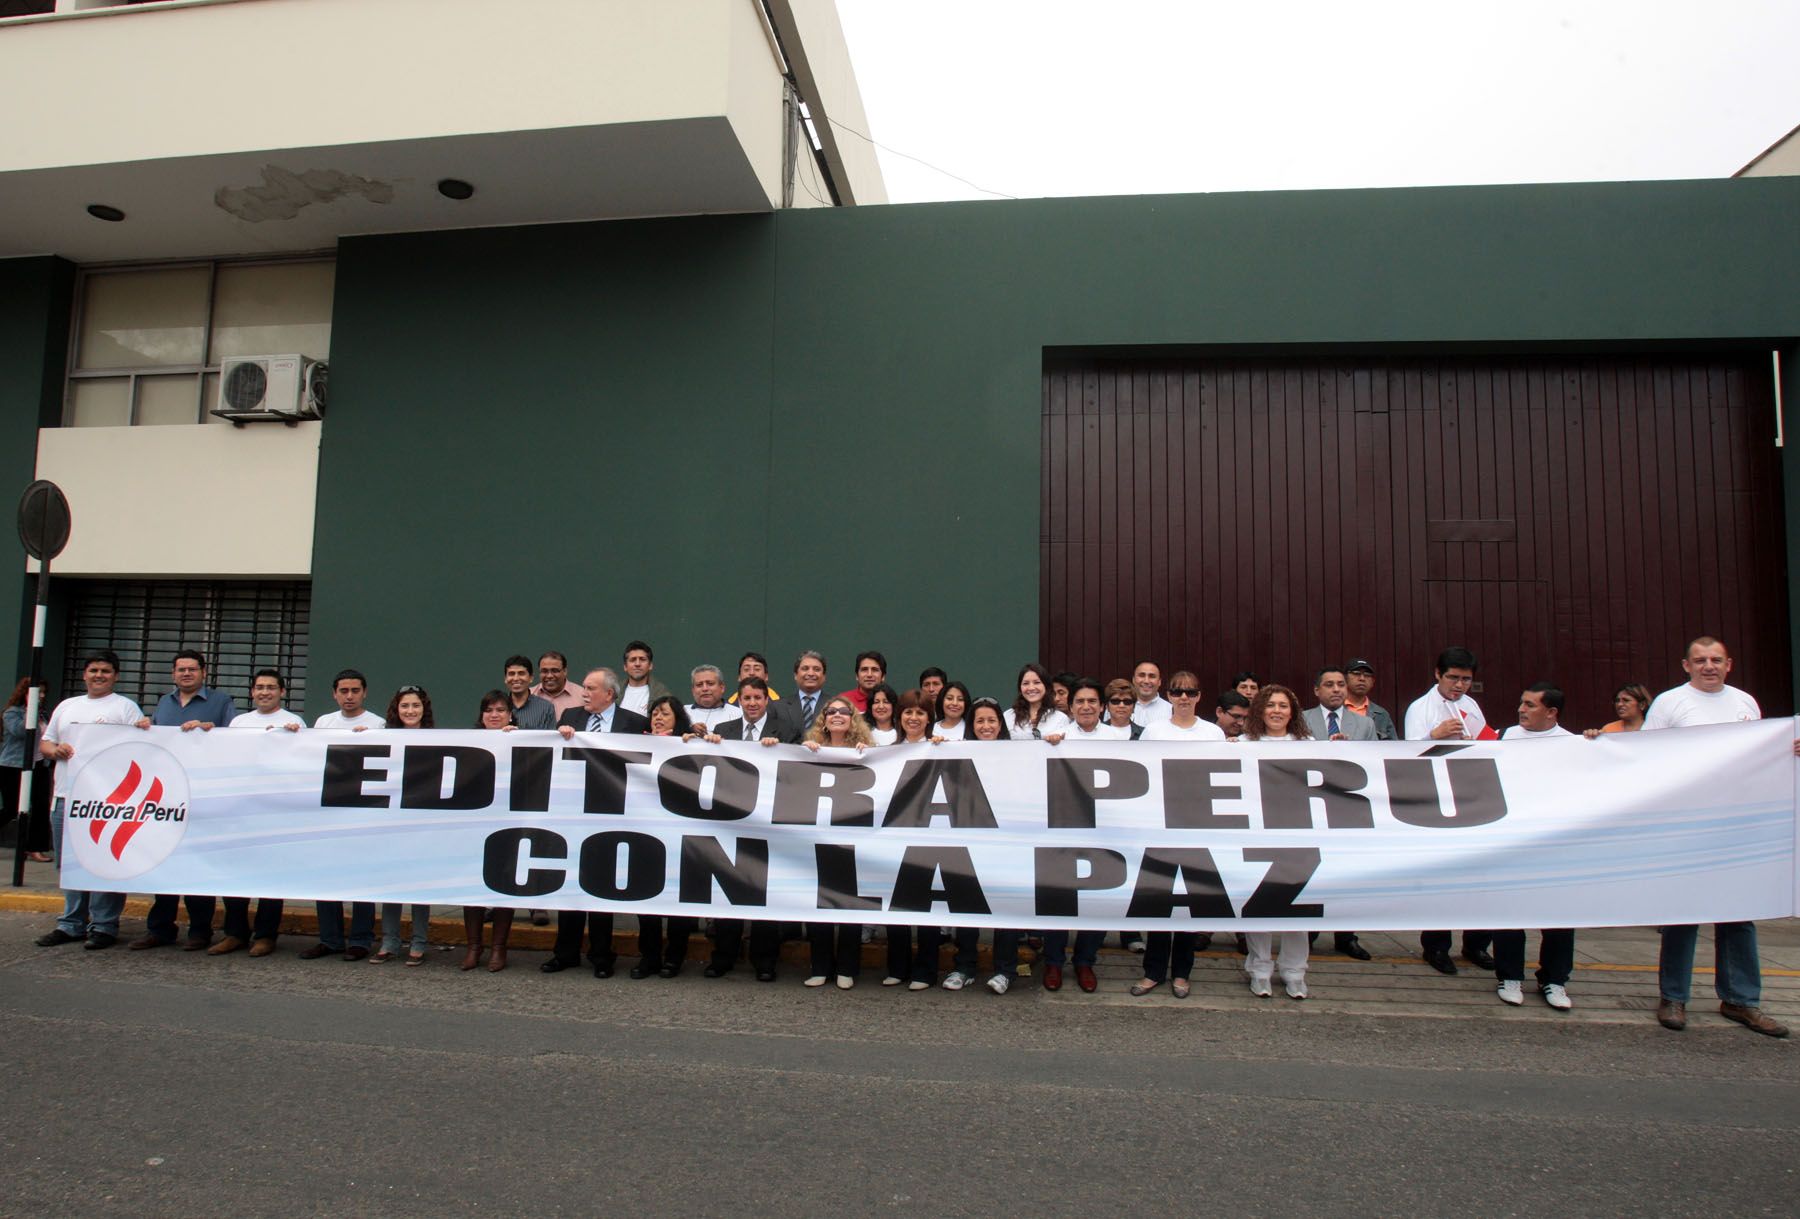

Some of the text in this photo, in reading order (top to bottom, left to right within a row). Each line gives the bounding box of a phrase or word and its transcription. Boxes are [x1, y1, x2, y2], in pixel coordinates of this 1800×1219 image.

[69, 799, 186, 822] Editora Perú
[320, 744, 1508, 829] EDITORA PERÚ
[482, 827, 1325, 919] CON LA PAZ
